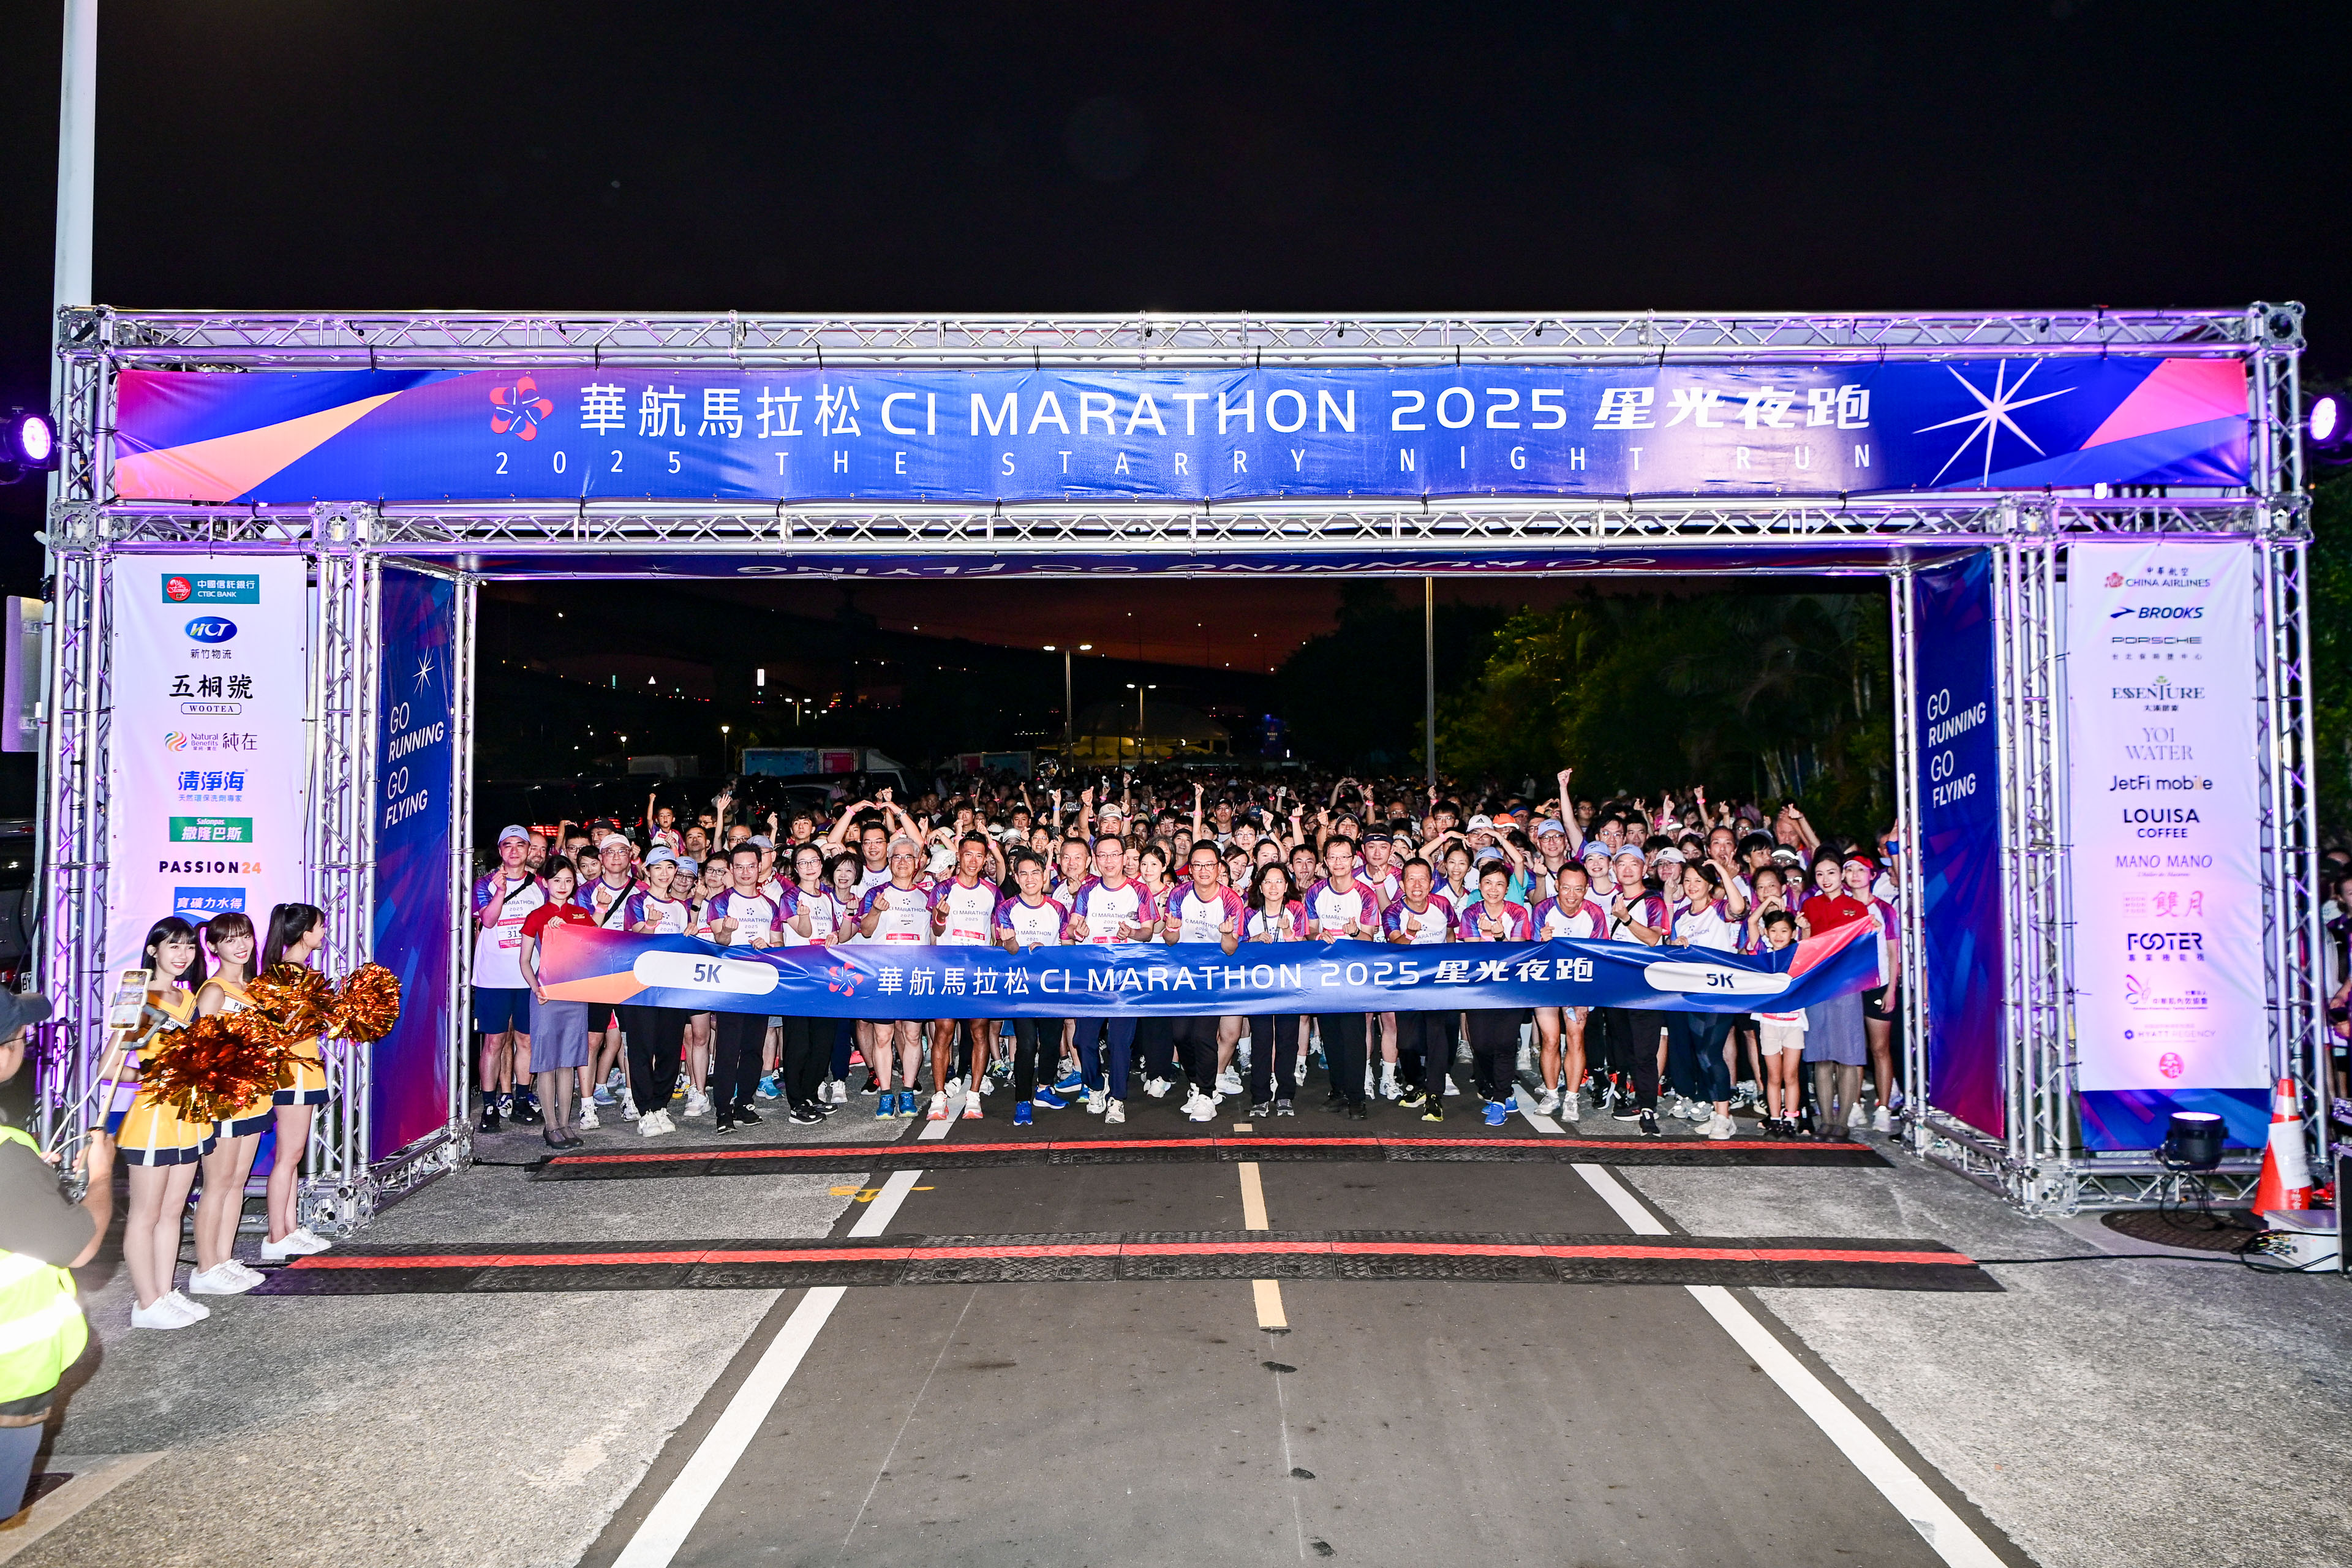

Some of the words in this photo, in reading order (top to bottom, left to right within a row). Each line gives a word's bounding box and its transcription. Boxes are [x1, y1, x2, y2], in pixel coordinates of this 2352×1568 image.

[580, 382, 861, 439] 華航馬拉松
[880, 392, 935, 435] CI
[971, 389, 1355, 436] MARATHON
[1392, 386, 1567, 431] 2025
[1592, 384, 1871, 431] 星光夜跑
[496, 450, 681, 475] 2025
[775, 450, 907, 476] THE
[1001, 449, 1306, 476] STARRY
[1400, 447, 1641, 472] NIGHT
[1736, 443, 1871, 470] RUN
[2147, 567, 2189, 576] 中華航空
[197, 580, 255, 589] 中國信託銀行
[2126, 579, 2158, 587] CHINA
[2162, 578, 2211, 587] AIRLINES
[2138, 607, 2204, 619] BROOKS
[190, 624, 231, 636] HCT
[190, 649, 232, 659] 新竹物流
[169, 674, 253, 699] 五桐號
[1928, 688, 1950, 721] GO
[390, 701, 410, 734] GO
[1928, 702, 1986, 748] RUNNING
[222, 733, 258, 752] 純在
[388, 721, 444, 763] RUNNING
[2142, 727, 2175, 743] YOI
[2125, 745, 2193, 761] WATER
[1931, 750, 1954, 782] GO
[178, 771, 245, 791] 清淨海
[388, 766, 409, 800] GO
[2109, 775, 2150, 791] JetFi
[1932, 773, 1977, 809] FLYING
[385, 789, 428, 829] FLYING
[2124, 809, 2199, 823] LOUISA
[181, 826, 242, 841] 撒隆巴斯
[2138, 828, 2188, 838] COFFEE
[2116, 855, 2161, 868] MANO
[2167, 855, 2212, 868] MANO
[176, 897, 243, 910] 寶礦力水得
[2128, 933, 2204, 950] FOOTER
[693, 963, 723, 983] 5K
[878, 967, 1030, 996] 華航馬拉松
[1041, 968, 1070, 993] CI
[1088, 963, 1301, 992] MARATHON
[1321, 961, 1420, 987] 2025
[1434, 957, 1593, 984] 星光夜跑
[1706, 973, 1735, 989] 5K
